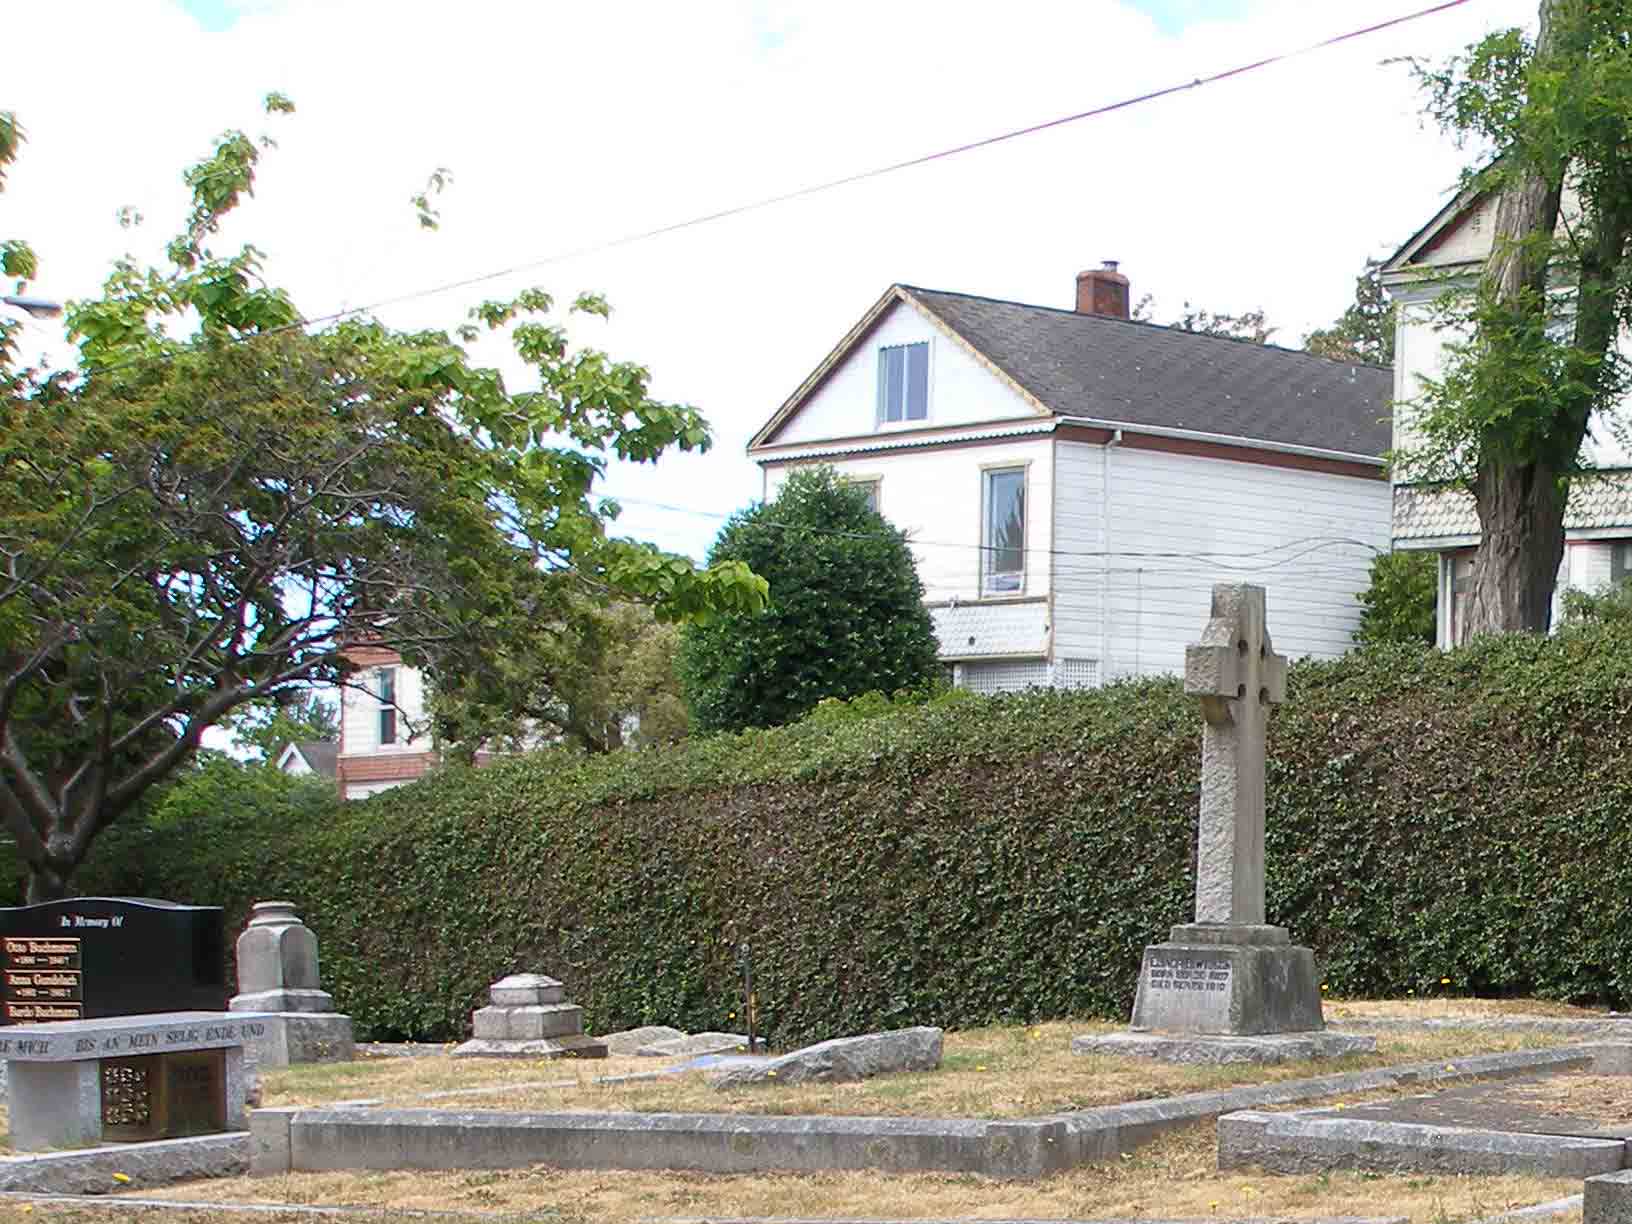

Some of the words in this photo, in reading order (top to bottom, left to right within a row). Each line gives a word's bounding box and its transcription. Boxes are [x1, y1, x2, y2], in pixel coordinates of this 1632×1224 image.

[75, 915, 109, 928] Memory
[112, 915, 124, 927] Of
[127, 1031, 160, 1049] MEIN
[205, 1025, 236, 1041] ENDE
[241, 1022, 265, 1038] UND
